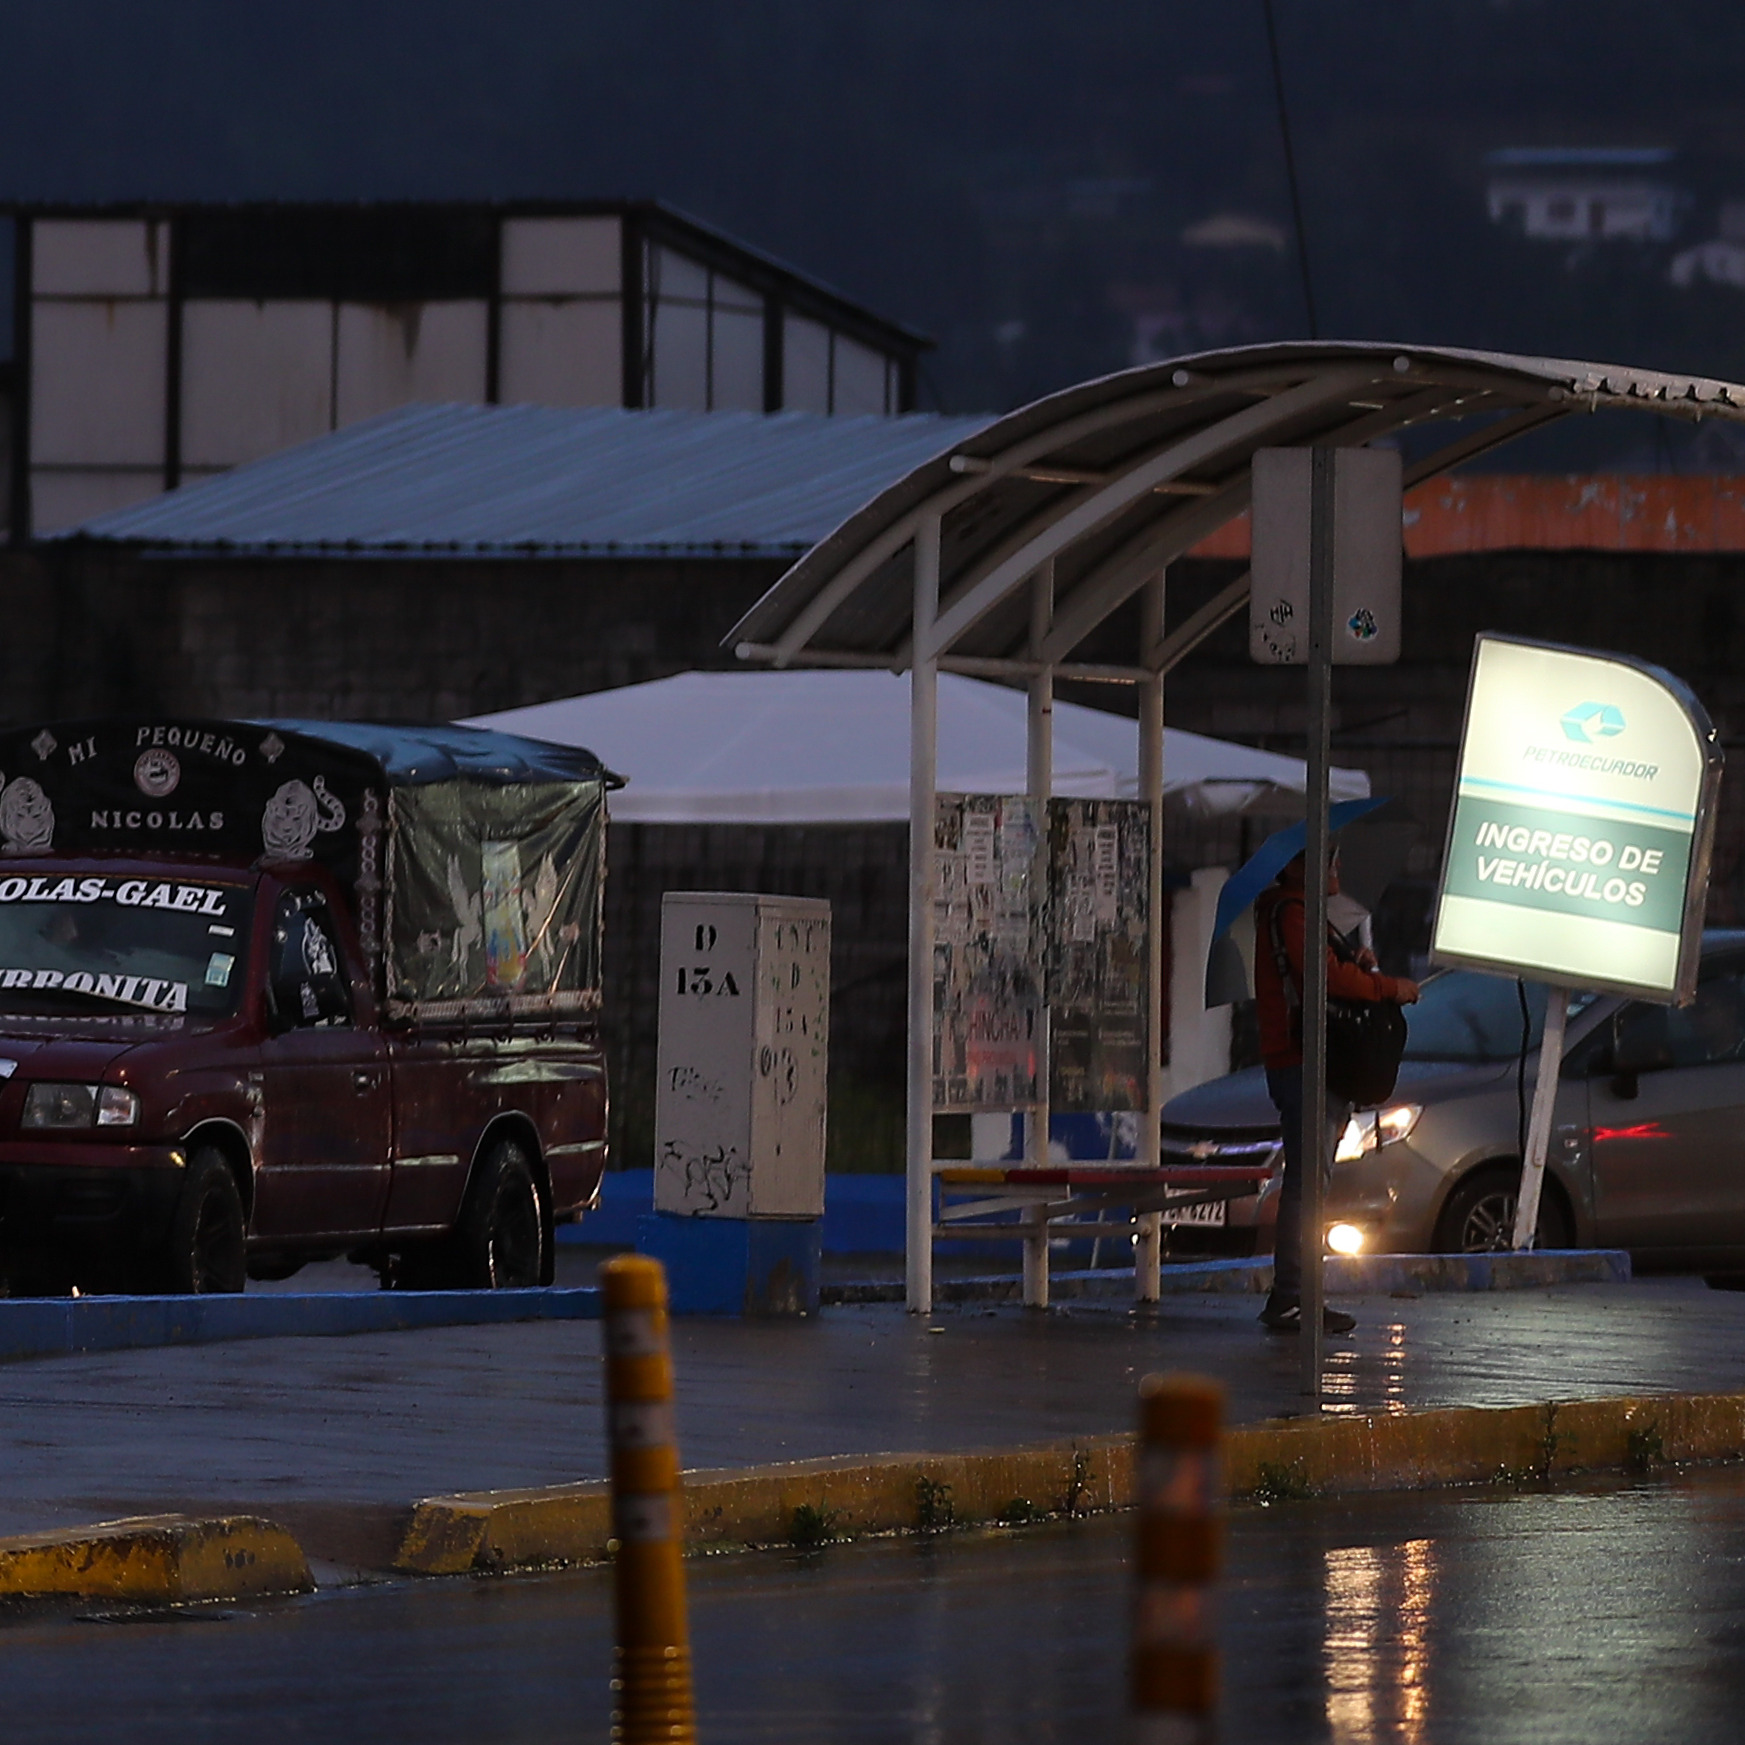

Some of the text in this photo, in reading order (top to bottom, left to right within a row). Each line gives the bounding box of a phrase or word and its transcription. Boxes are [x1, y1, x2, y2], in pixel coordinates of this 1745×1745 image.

[67, 735, 98, 767] MI
[135, 725, 247, 767] PEQUEÑO
[1522, 745, 1659, 781] PETROECUADOR
[89, 810, 225, 831] NICOLAS
[1475, 821, 1664, 875] INGRESO DE
[1476, 855, 1647, 907] VEHÍCULOS
